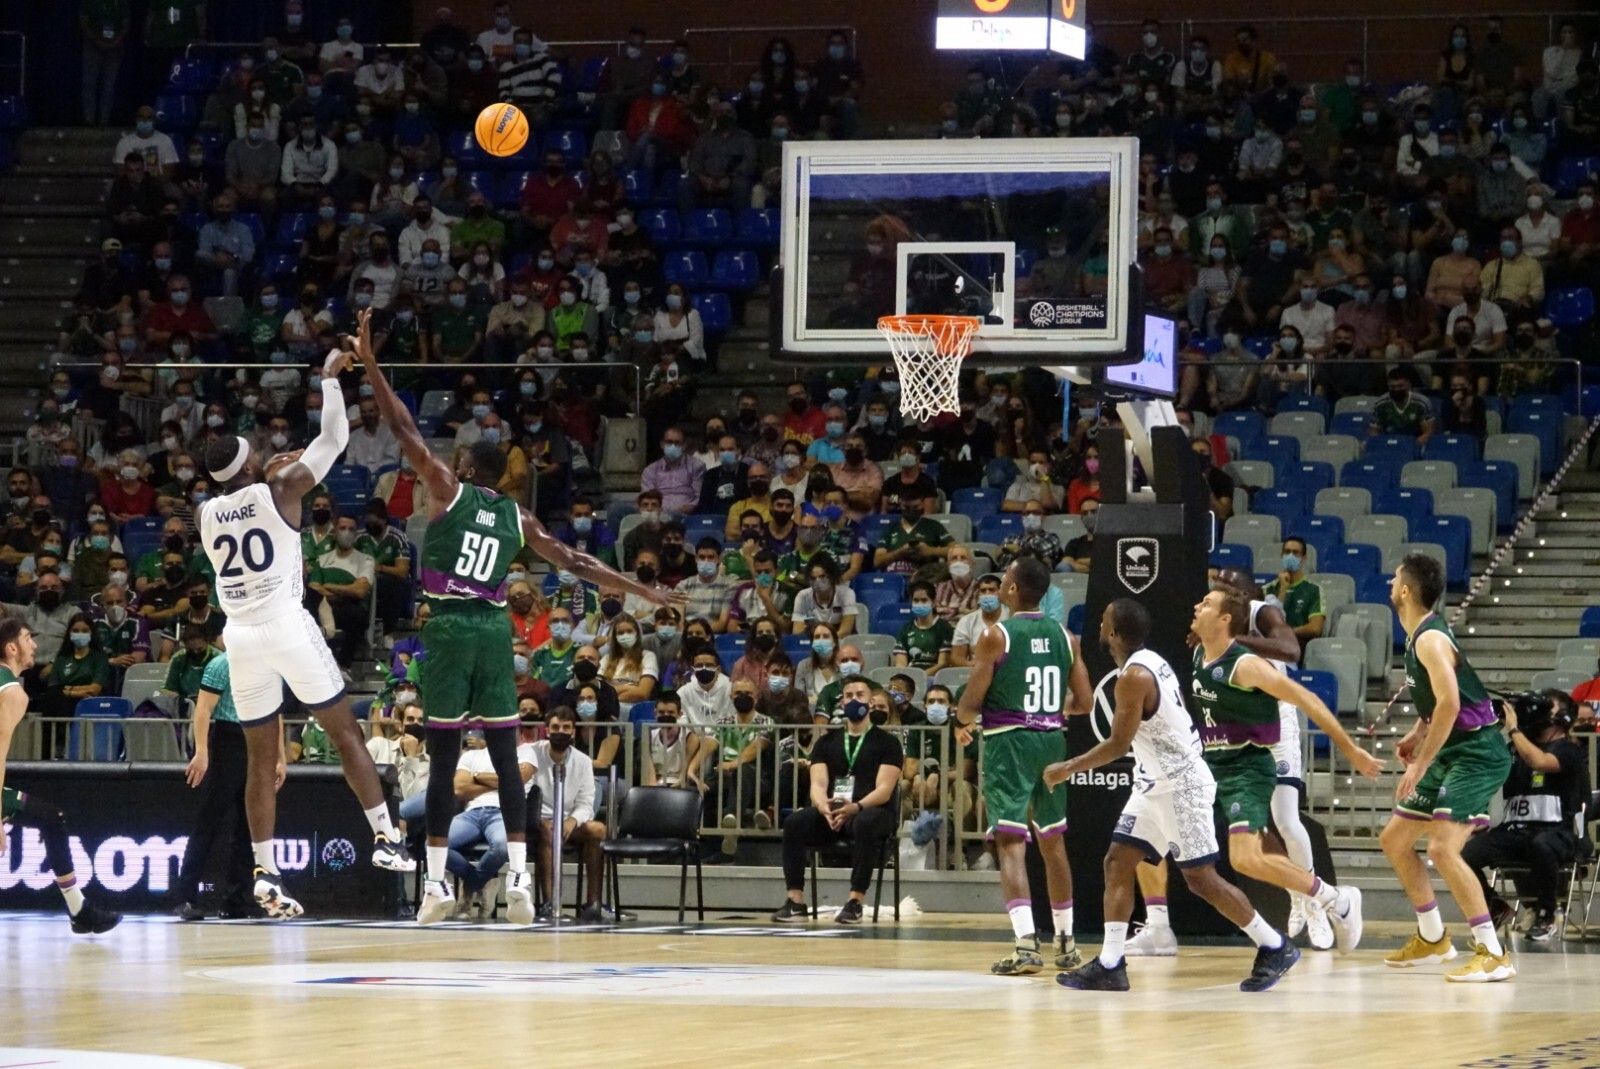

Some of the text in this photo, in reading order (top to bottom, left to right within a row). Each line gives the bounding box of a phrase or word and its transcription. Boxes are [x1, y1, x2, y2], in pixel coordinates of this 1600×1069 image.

[496, 107, 517, 134] Wilson
[215, 504, 256, 524] WARE
[475, 509, 496, 527] ERIC
[213, 528, 274, 577] 20
[455, 531, 500, 582] 50
[1031, 638, 1050, 653] COLE
[1024, 665, 1060, 712] 30
